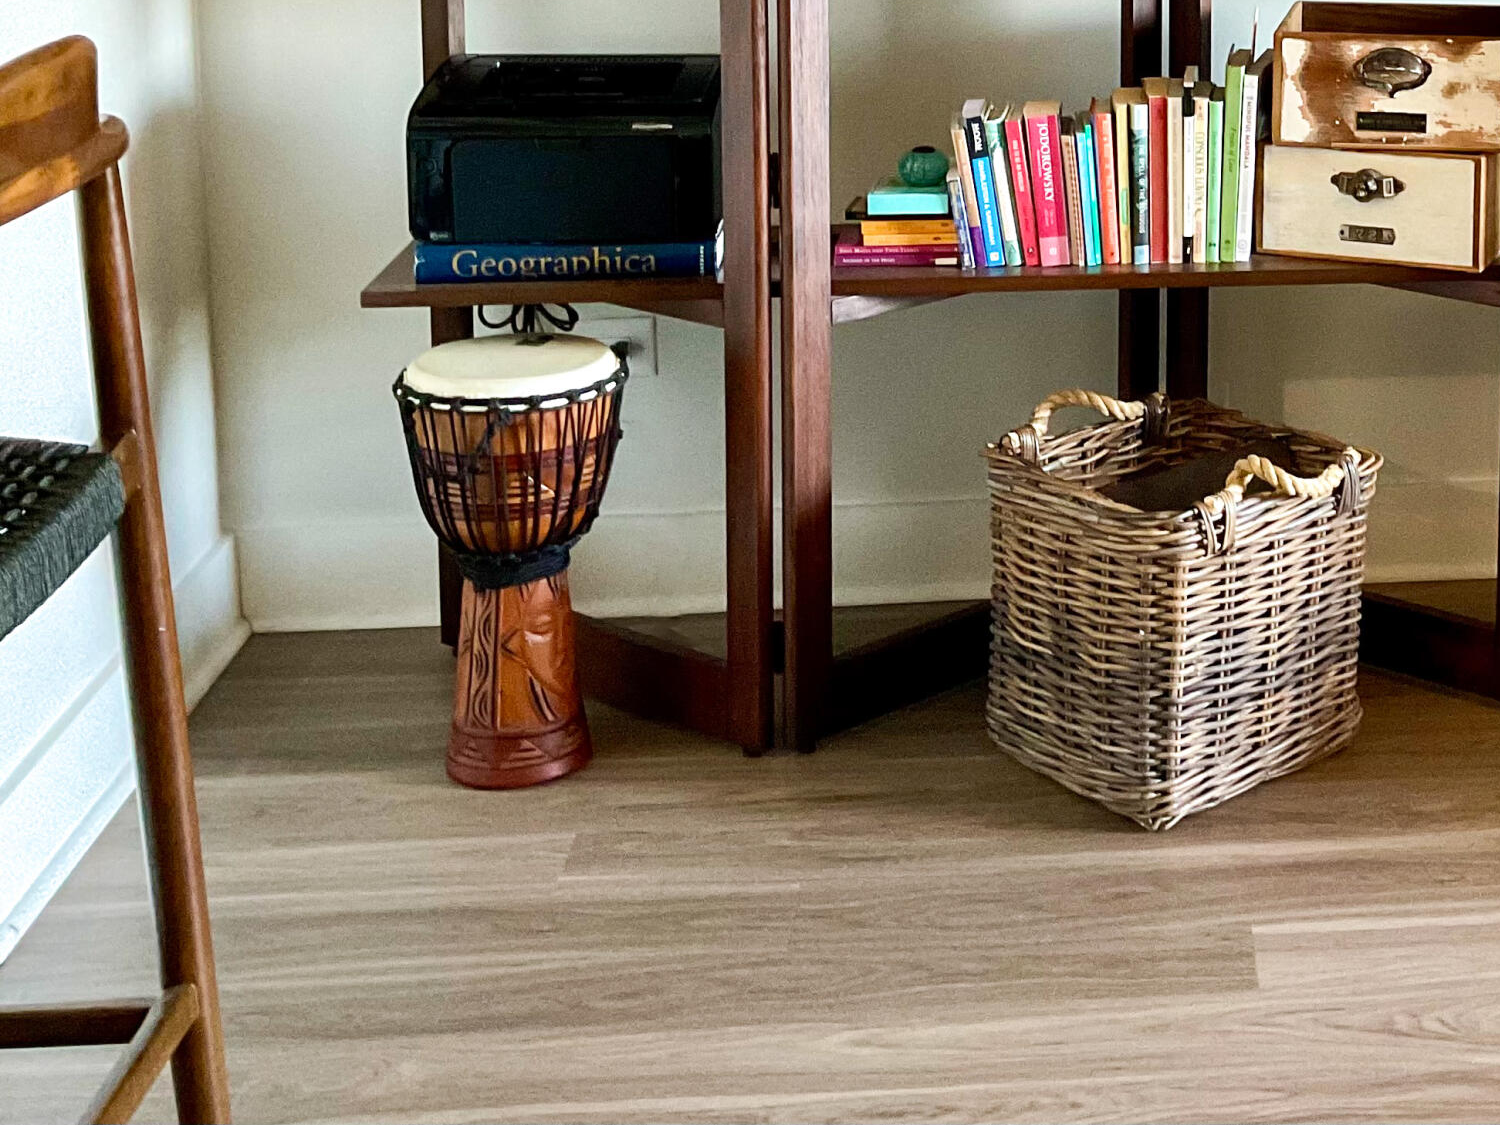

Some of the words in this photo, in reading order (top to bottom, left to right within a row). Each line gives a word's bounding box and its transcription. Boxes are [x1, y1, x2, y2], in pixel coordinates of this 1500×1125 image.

[1244, 101, 1252, 134] MINDFUL
[971, 123, 984, 153] MOON
[1243, 134, 1251, 170] MANDALA
[1037, 123, 1055, 203] JODOROWSKY
[1138, 178, 1145, 186] OF
[451, 246, 656, 279] Geographica
